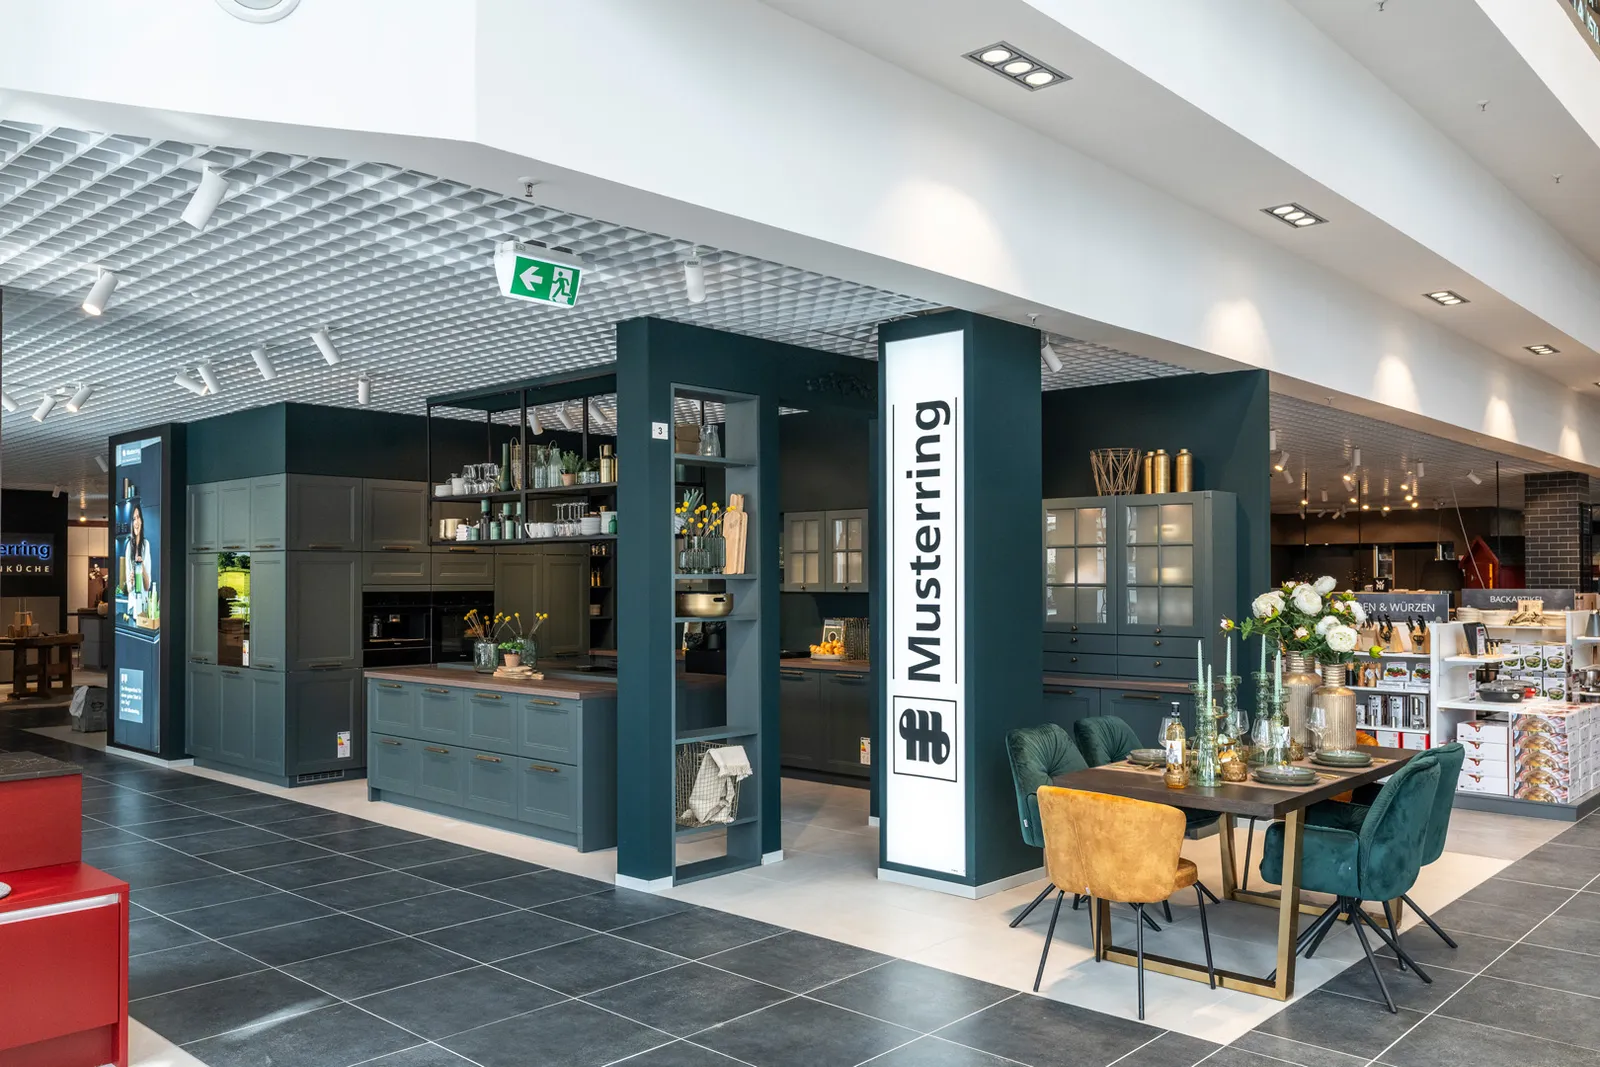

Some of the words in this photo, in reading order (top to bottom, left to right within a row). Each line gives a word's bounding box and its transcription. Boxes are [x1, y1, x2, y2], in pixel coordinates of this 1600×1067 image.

[658, 427, 663, 435] 3
[906, 400, 951, 683] Musterring
[1379, 603, 1387, 611] &
[1390, 602, 1434, 612] WÜRZEN
